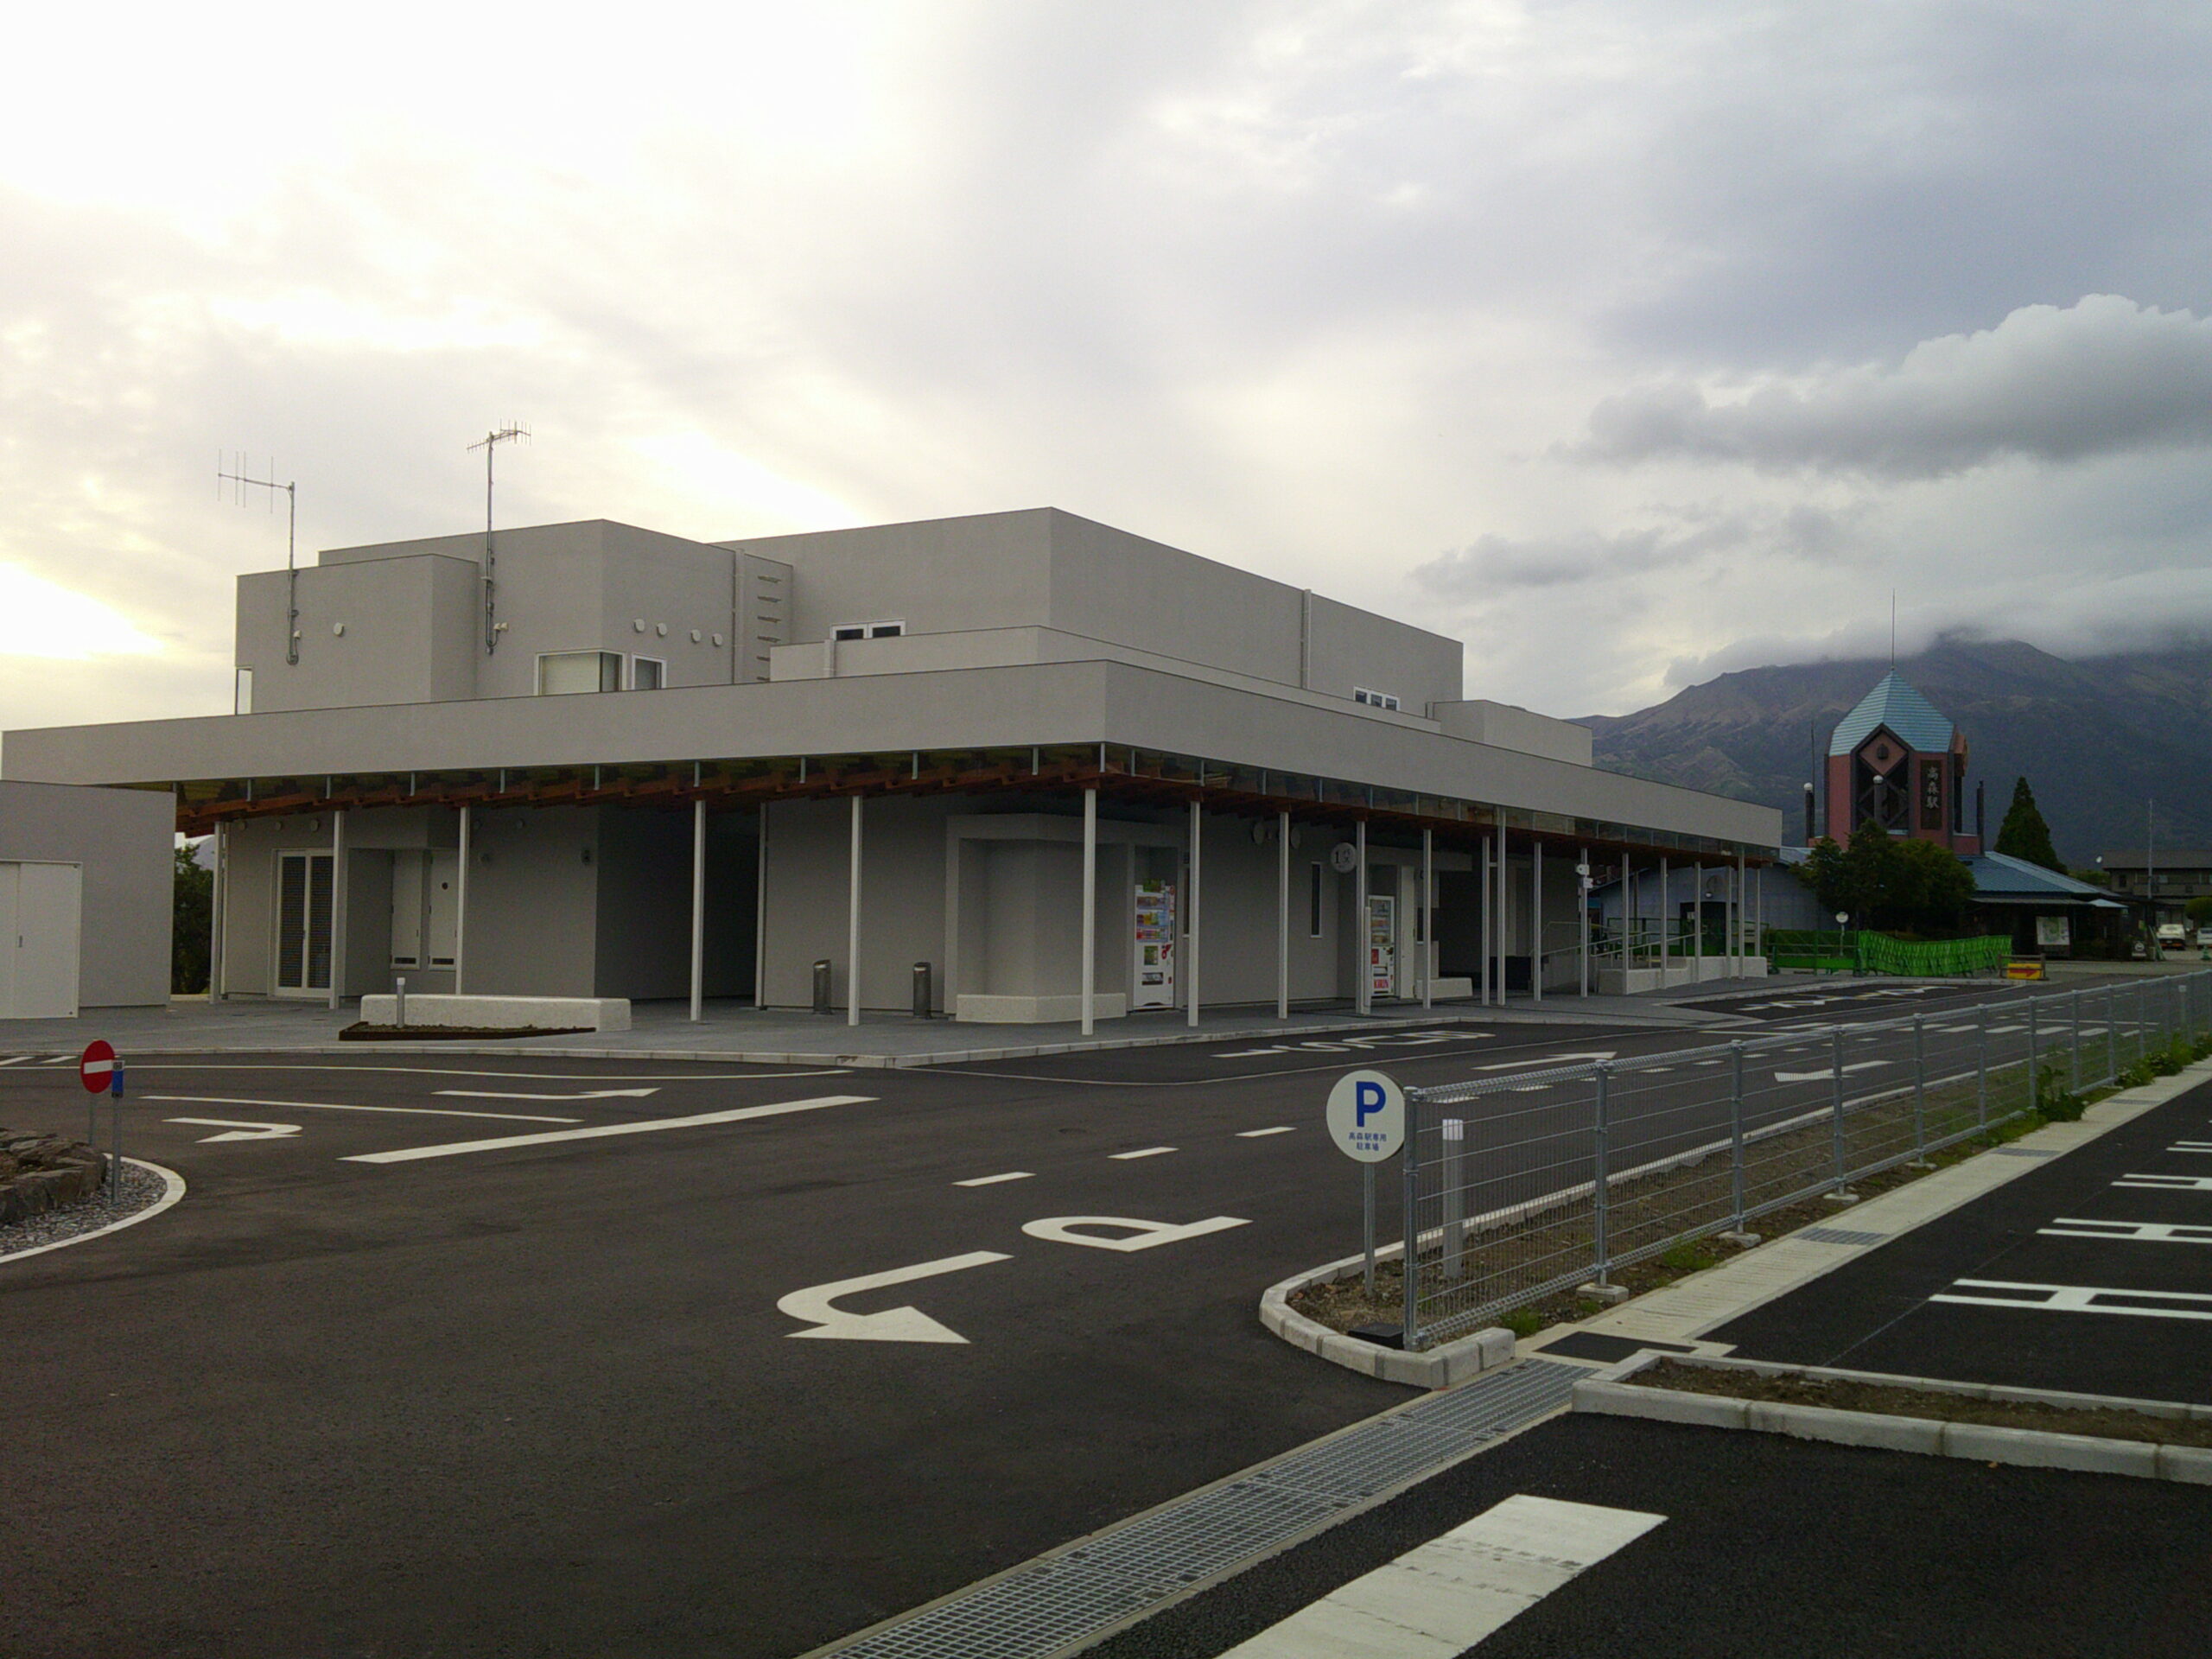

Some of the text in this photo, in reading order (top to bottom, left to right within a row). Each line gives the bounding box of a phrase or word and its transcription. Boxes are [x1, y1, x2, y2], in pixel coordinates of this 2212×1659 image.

[1926, 766, 1939, 810] 高森駅
[1356, 1081, 1386, 1127] P
[1349, 1132, 1387, 1141] 高森駅専用
[1357, 1142, 1379, 1151] 駐車場
